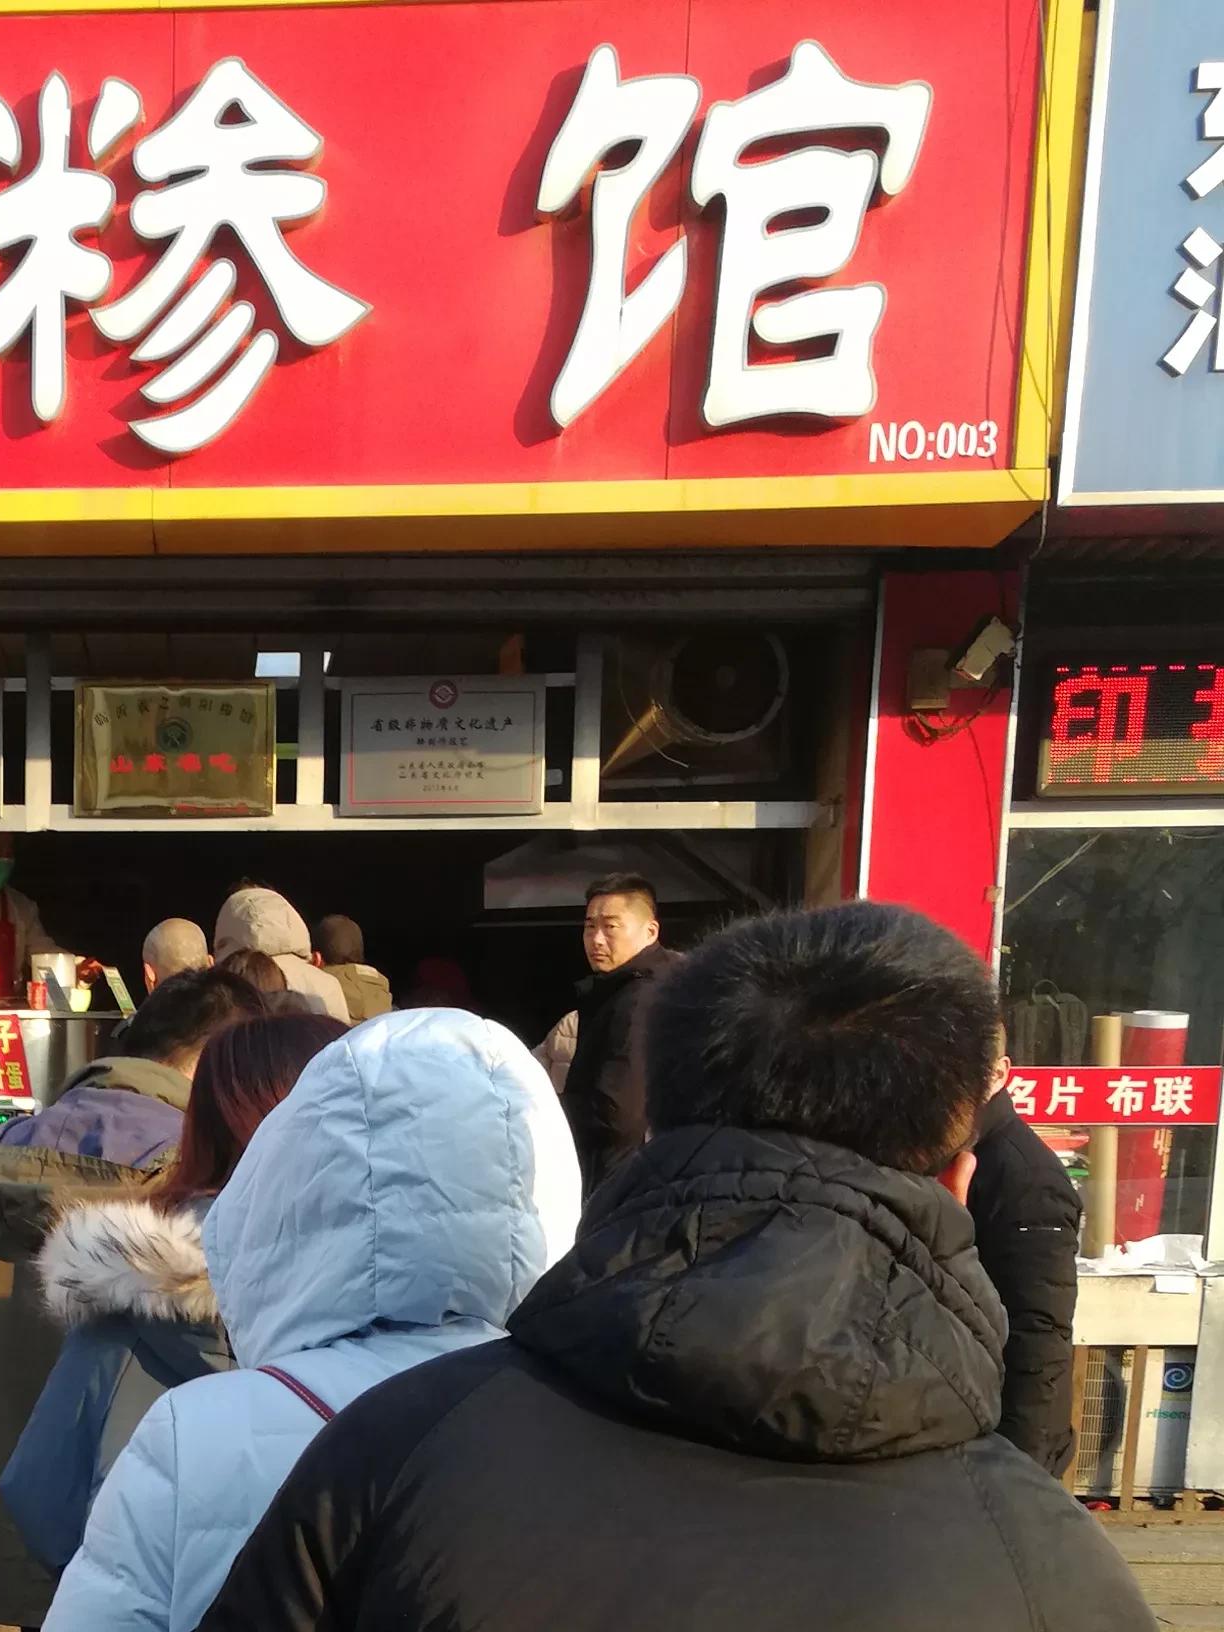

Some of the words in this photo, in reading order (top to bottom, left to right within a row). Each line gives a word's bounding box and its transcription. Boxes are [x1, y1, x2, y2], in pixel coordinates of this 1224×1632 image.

[869, 420, 999, 464] NO:003
[371, 715, 514, 733] 省级非物质文化遗产
[1007, 1076, 1084, 1116] 名片
[1106, 1075, 1194, 1117] 布联
